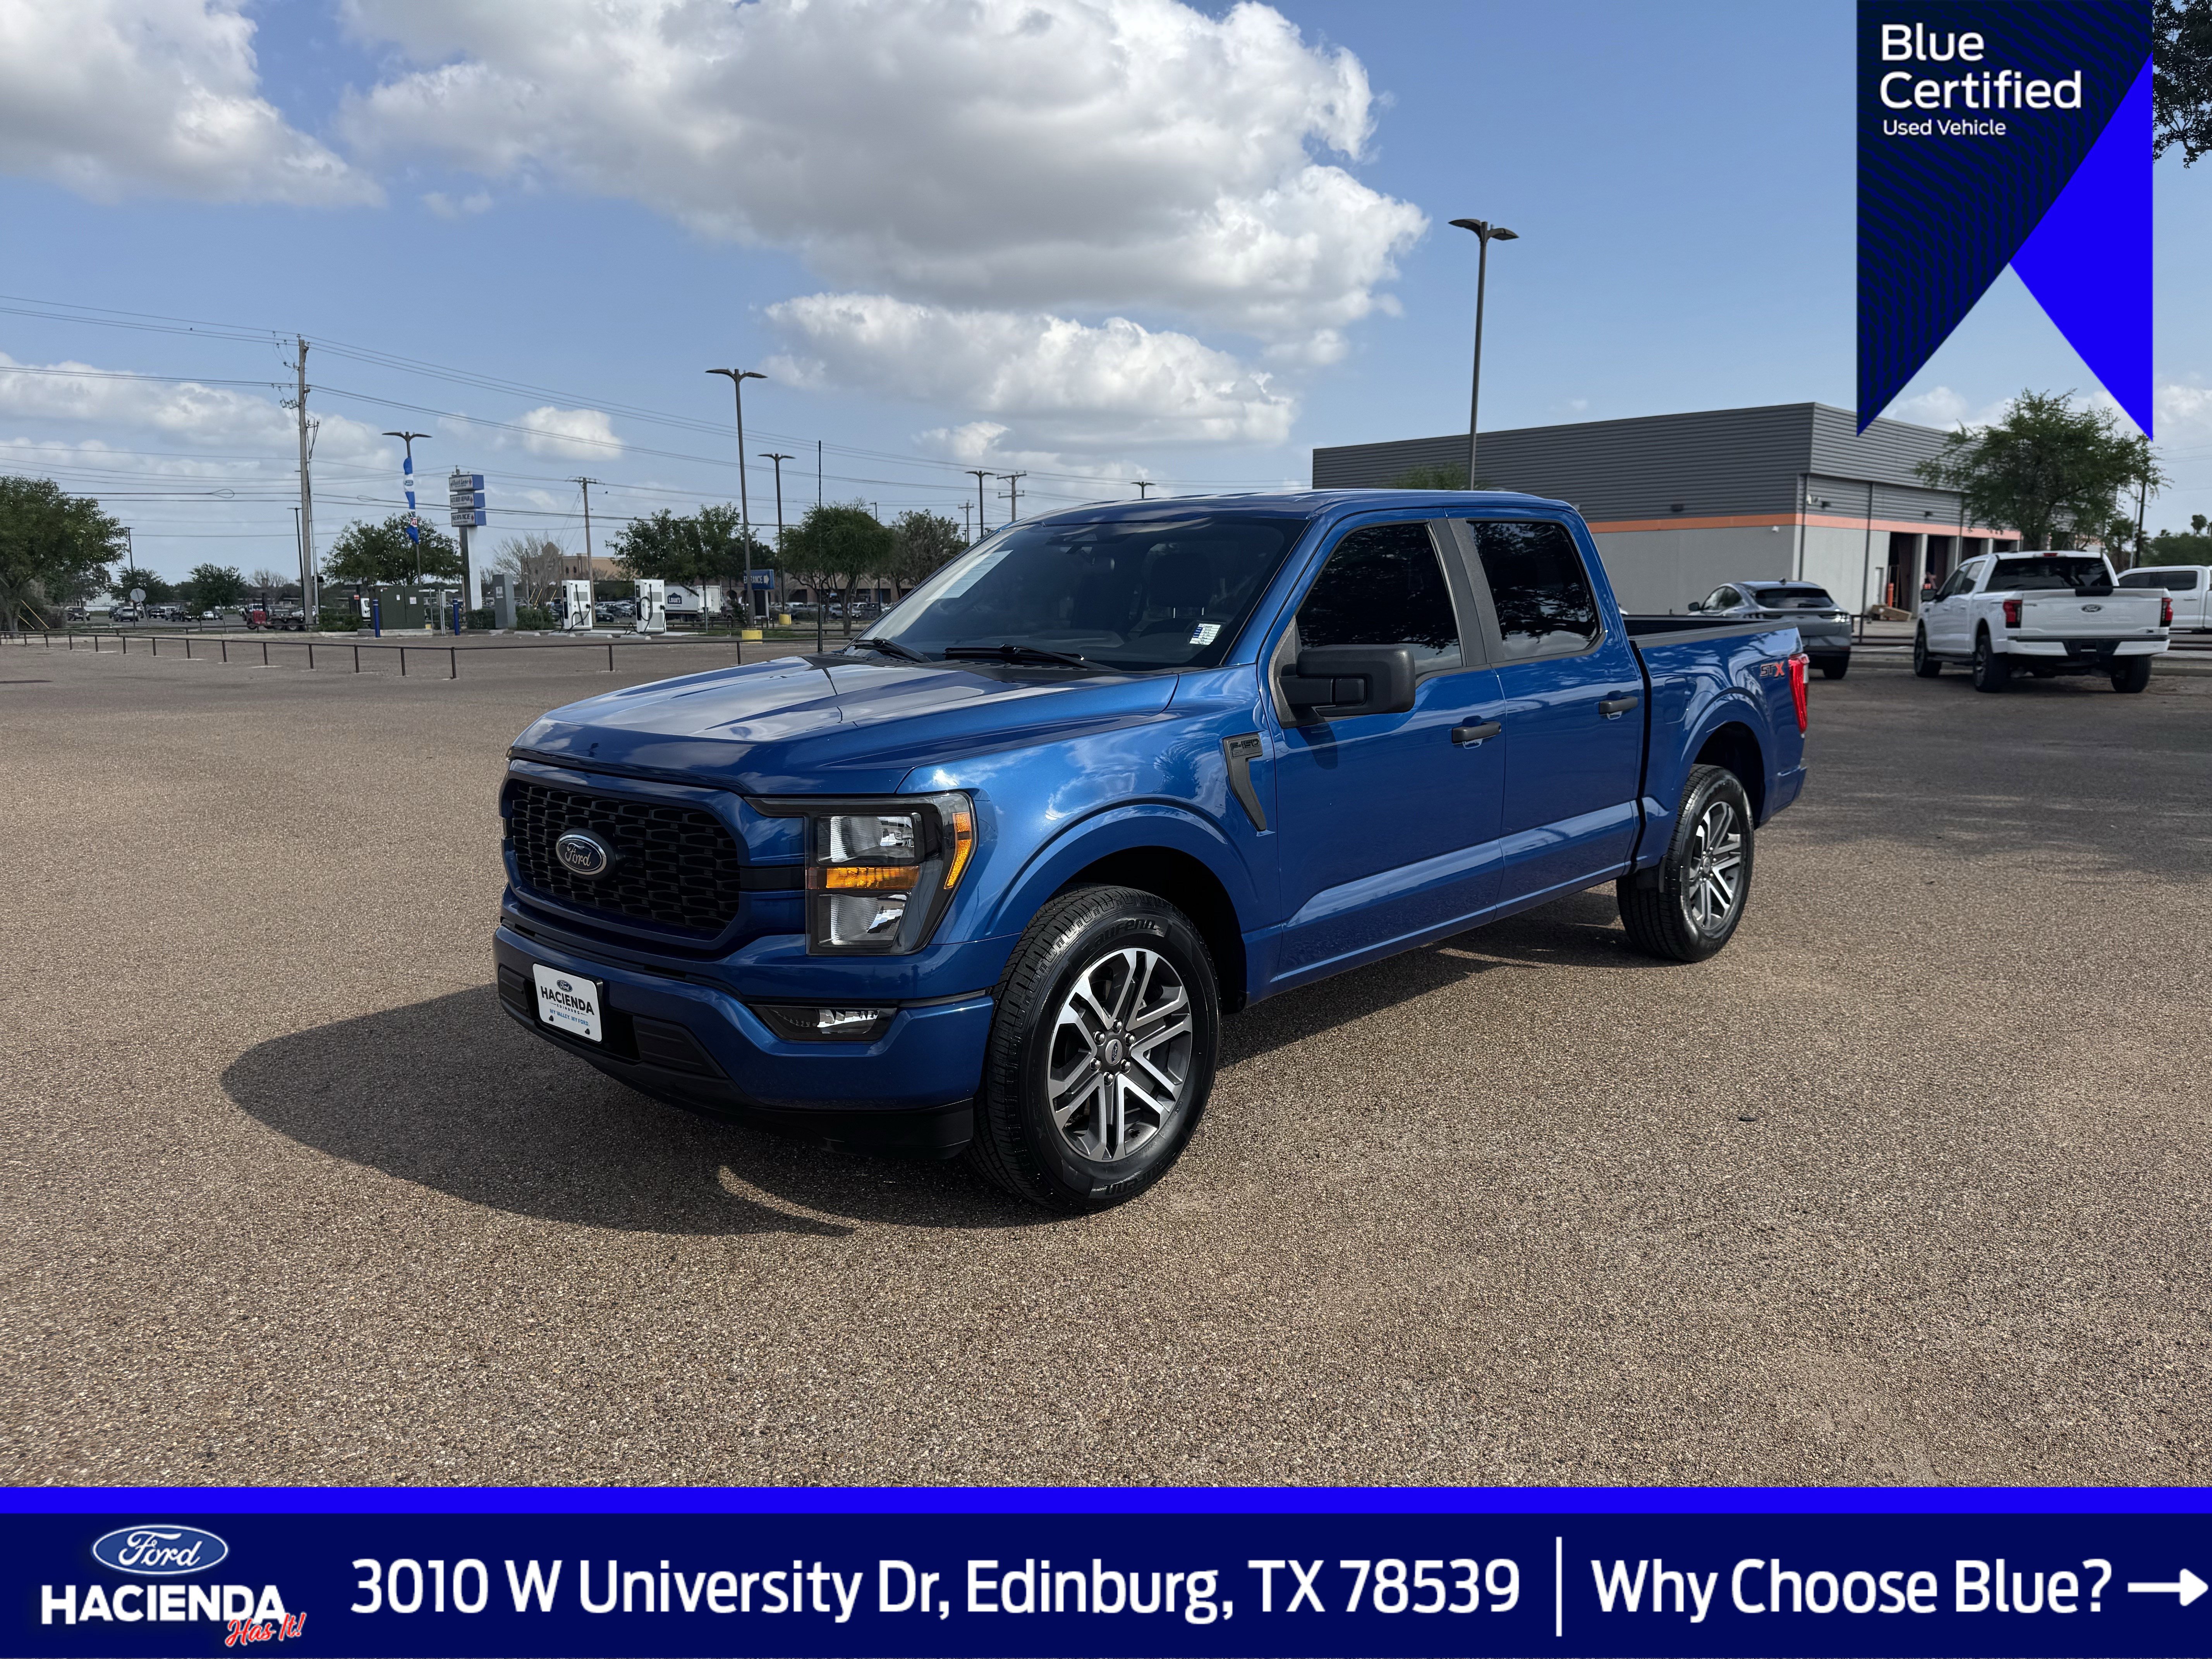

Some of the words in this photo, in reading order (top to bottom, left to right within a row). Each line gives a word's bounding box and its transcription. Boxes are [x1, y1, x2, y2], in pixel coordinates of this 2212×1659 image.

[1760, 661, 1784, 678] STX
[1230, 738, 1260, 750] F-150
[565, 842, 592, 867] Ford
[540, 986, 595, 1015] HACIENDA
